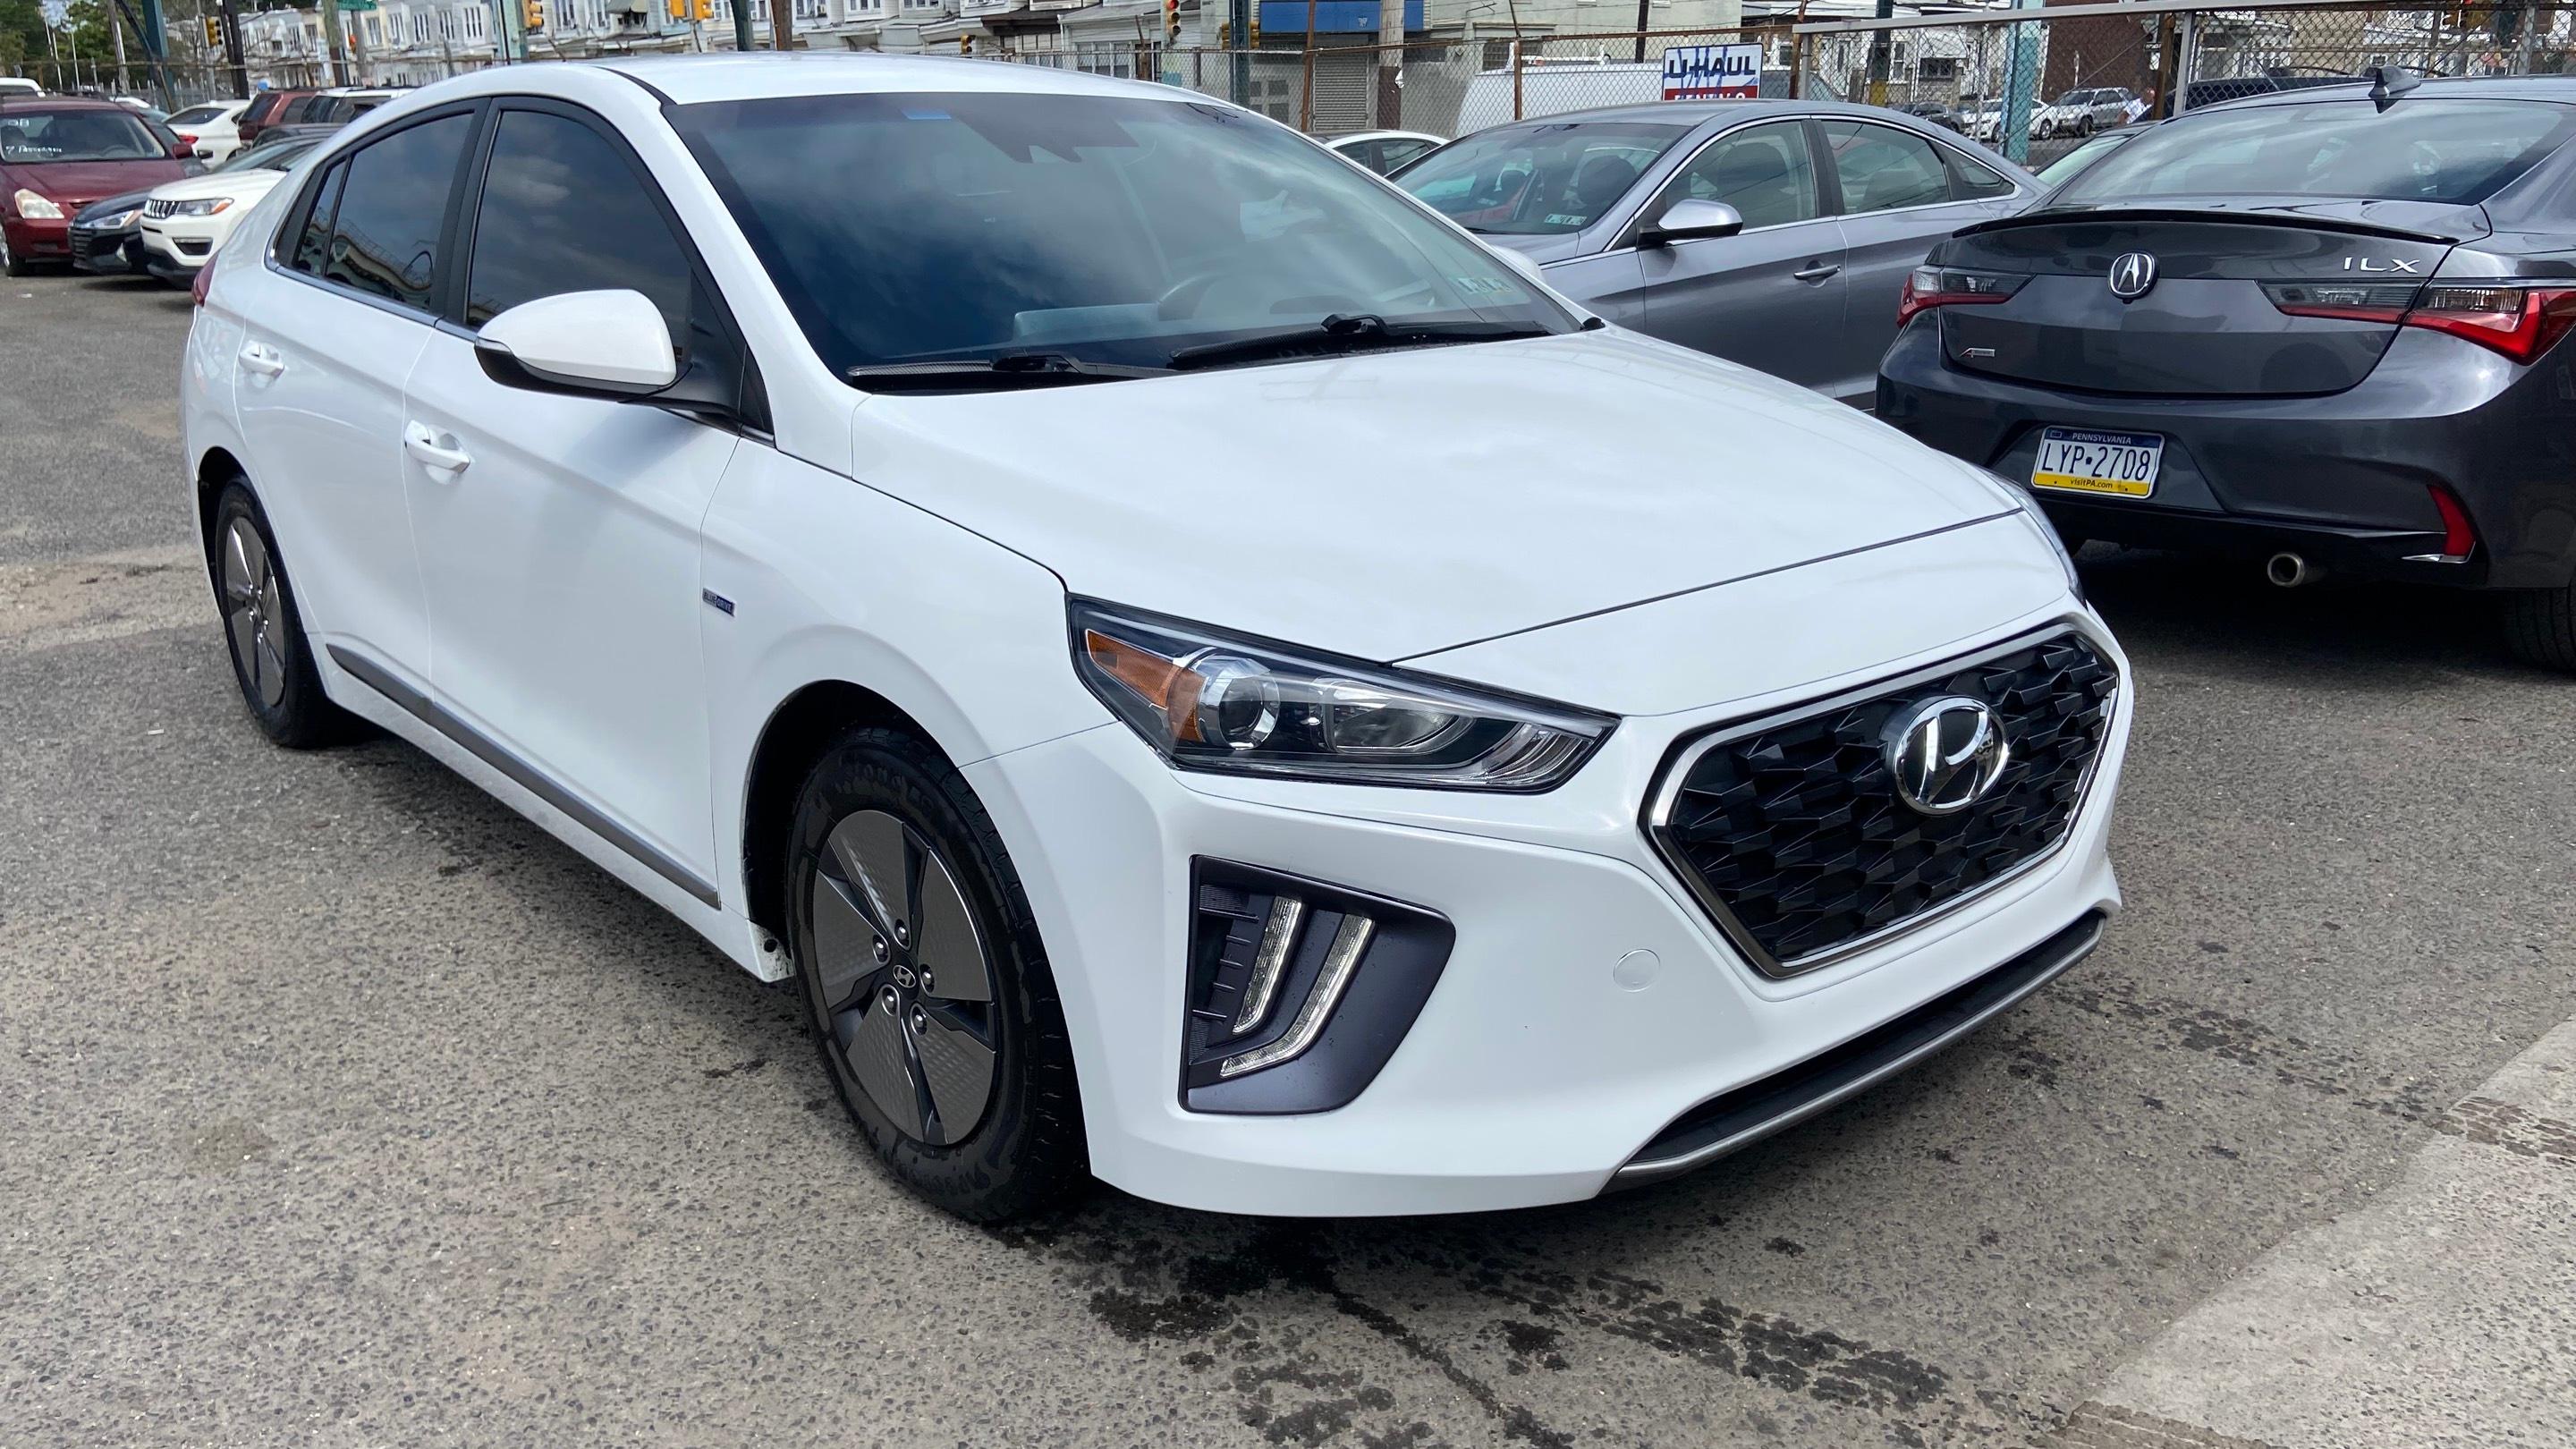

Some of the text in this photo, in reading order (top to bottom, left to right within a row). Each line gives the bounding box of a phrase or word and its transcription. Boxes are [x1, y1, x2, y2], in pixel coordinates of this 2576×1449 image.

[1669, 56, 1756, 78] U-HAUL
[2343, 257, 2420, 274] ILX
[2072, 433, 2131, 445] PENNSYLVANIA
[2070, 479, 2114, 489] visitPA.com
